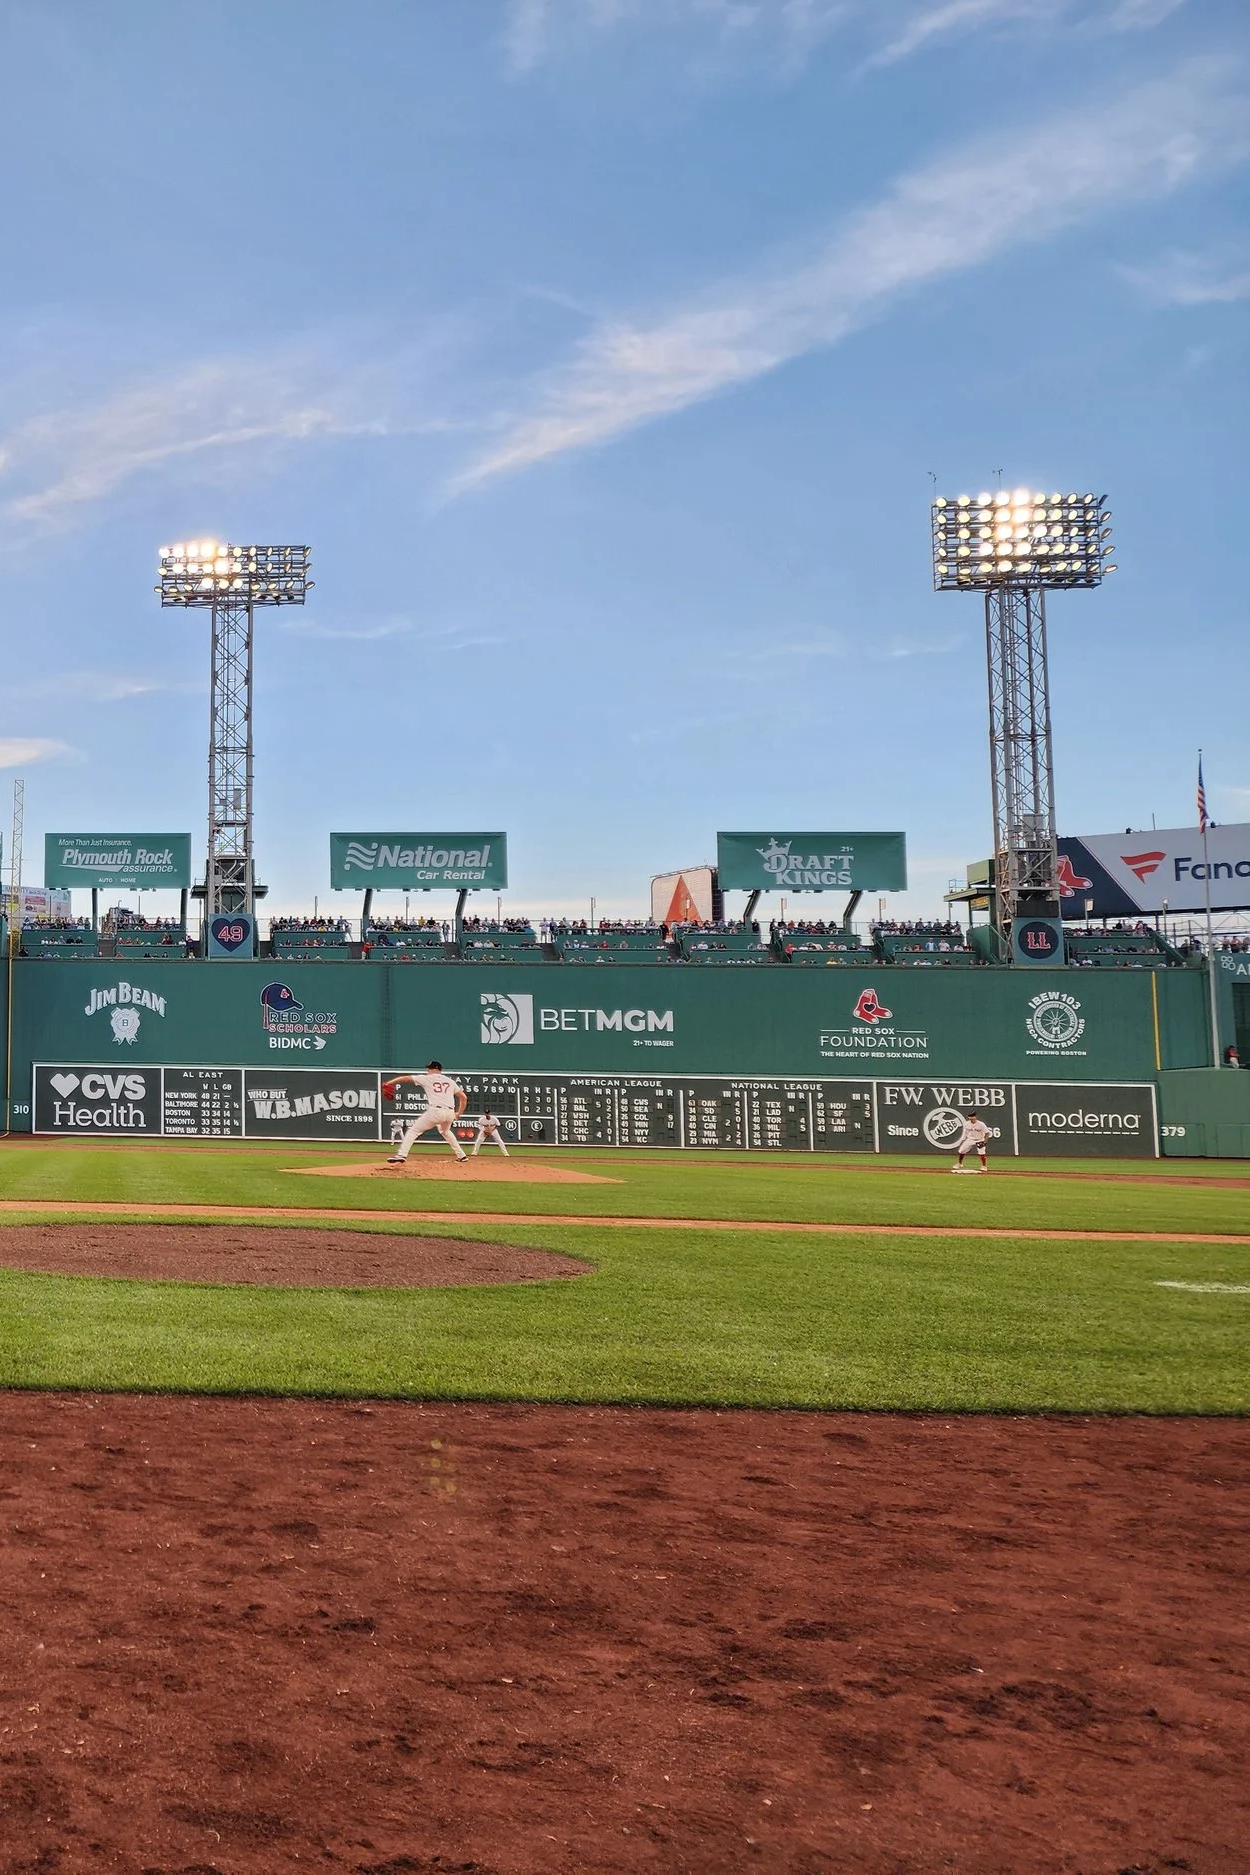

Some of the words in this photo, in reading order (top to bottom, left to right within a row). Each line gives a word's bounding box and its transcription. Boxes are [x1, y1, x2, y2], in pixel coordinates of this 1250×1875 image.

[62, 848, 131, 866] Plymouth
[134, 848, 173, 865] Rock
[763, 853, 854, 873] DRAFT
[122, 865, 173, 873] assurance
[417, 870, 440, 880] Car
[443, 870, 485, 880] Rental
[775, 870, 853, 885] KINGS
[218, 926, 243, 942] 49
[1027, 931, 1051, 950] LL
[84, 988, 117, 1016] JIM
[118, 982, 166, 1018] BEAM
[1028, 991, 1060, 1009] IBEW
[1060, 993, 1082, 1010] 103
[269, 1012, 301, 1023] RED
[305, 1012, 337, 1023] SOX
[541, 1009, 674, 1032] BETMGM
[269, 1023, 337, 1033] SCHOLARS
[852, 1027, 871, 1035] RED
[875, 1027, 895, 1035] SOX
[1037, 1018, 1086, 1049] CONTRACTORS
[269, 1037, 311, 1049] BIDMC
[820, 1036, 927, 1048] FOUNDATION
[81, 1073, 147, 1100] CVS
[432, 1082, 450, 1093] 37
[731, 1082, 779, 1090] NATIONAL
[784, 1083, 823, 1091] LEAGUE
[247, 1090, 267, 1099] WHO
[270, 1090, 286, 1099] BUT
[883, 1086, 925, 1106] F.W.
[931, 1087, 1006, 1106] WEBB
[574, 1097, 587, 1105] ATL
[634, 1098, 648, 1106] CWS
[13, 1105, 29, 1115] 310
[574, 1104, 587, 1112] BAL
[53, 1101, 147, 1128] Health
[326, 1114, 352, 1122] SINCE
[354, 1115, 373, 1123] 1898
[1028, 1109, 1139, 1129] moderna
[573, 1127, 589, 1135] CHC
[703, 1122, 716, 1130] CIN
[888, 1125, 919, 1136] Since
[935, 1120, 958, 1136] WEBB
[1161, 1126, 1186, 1137] 379
